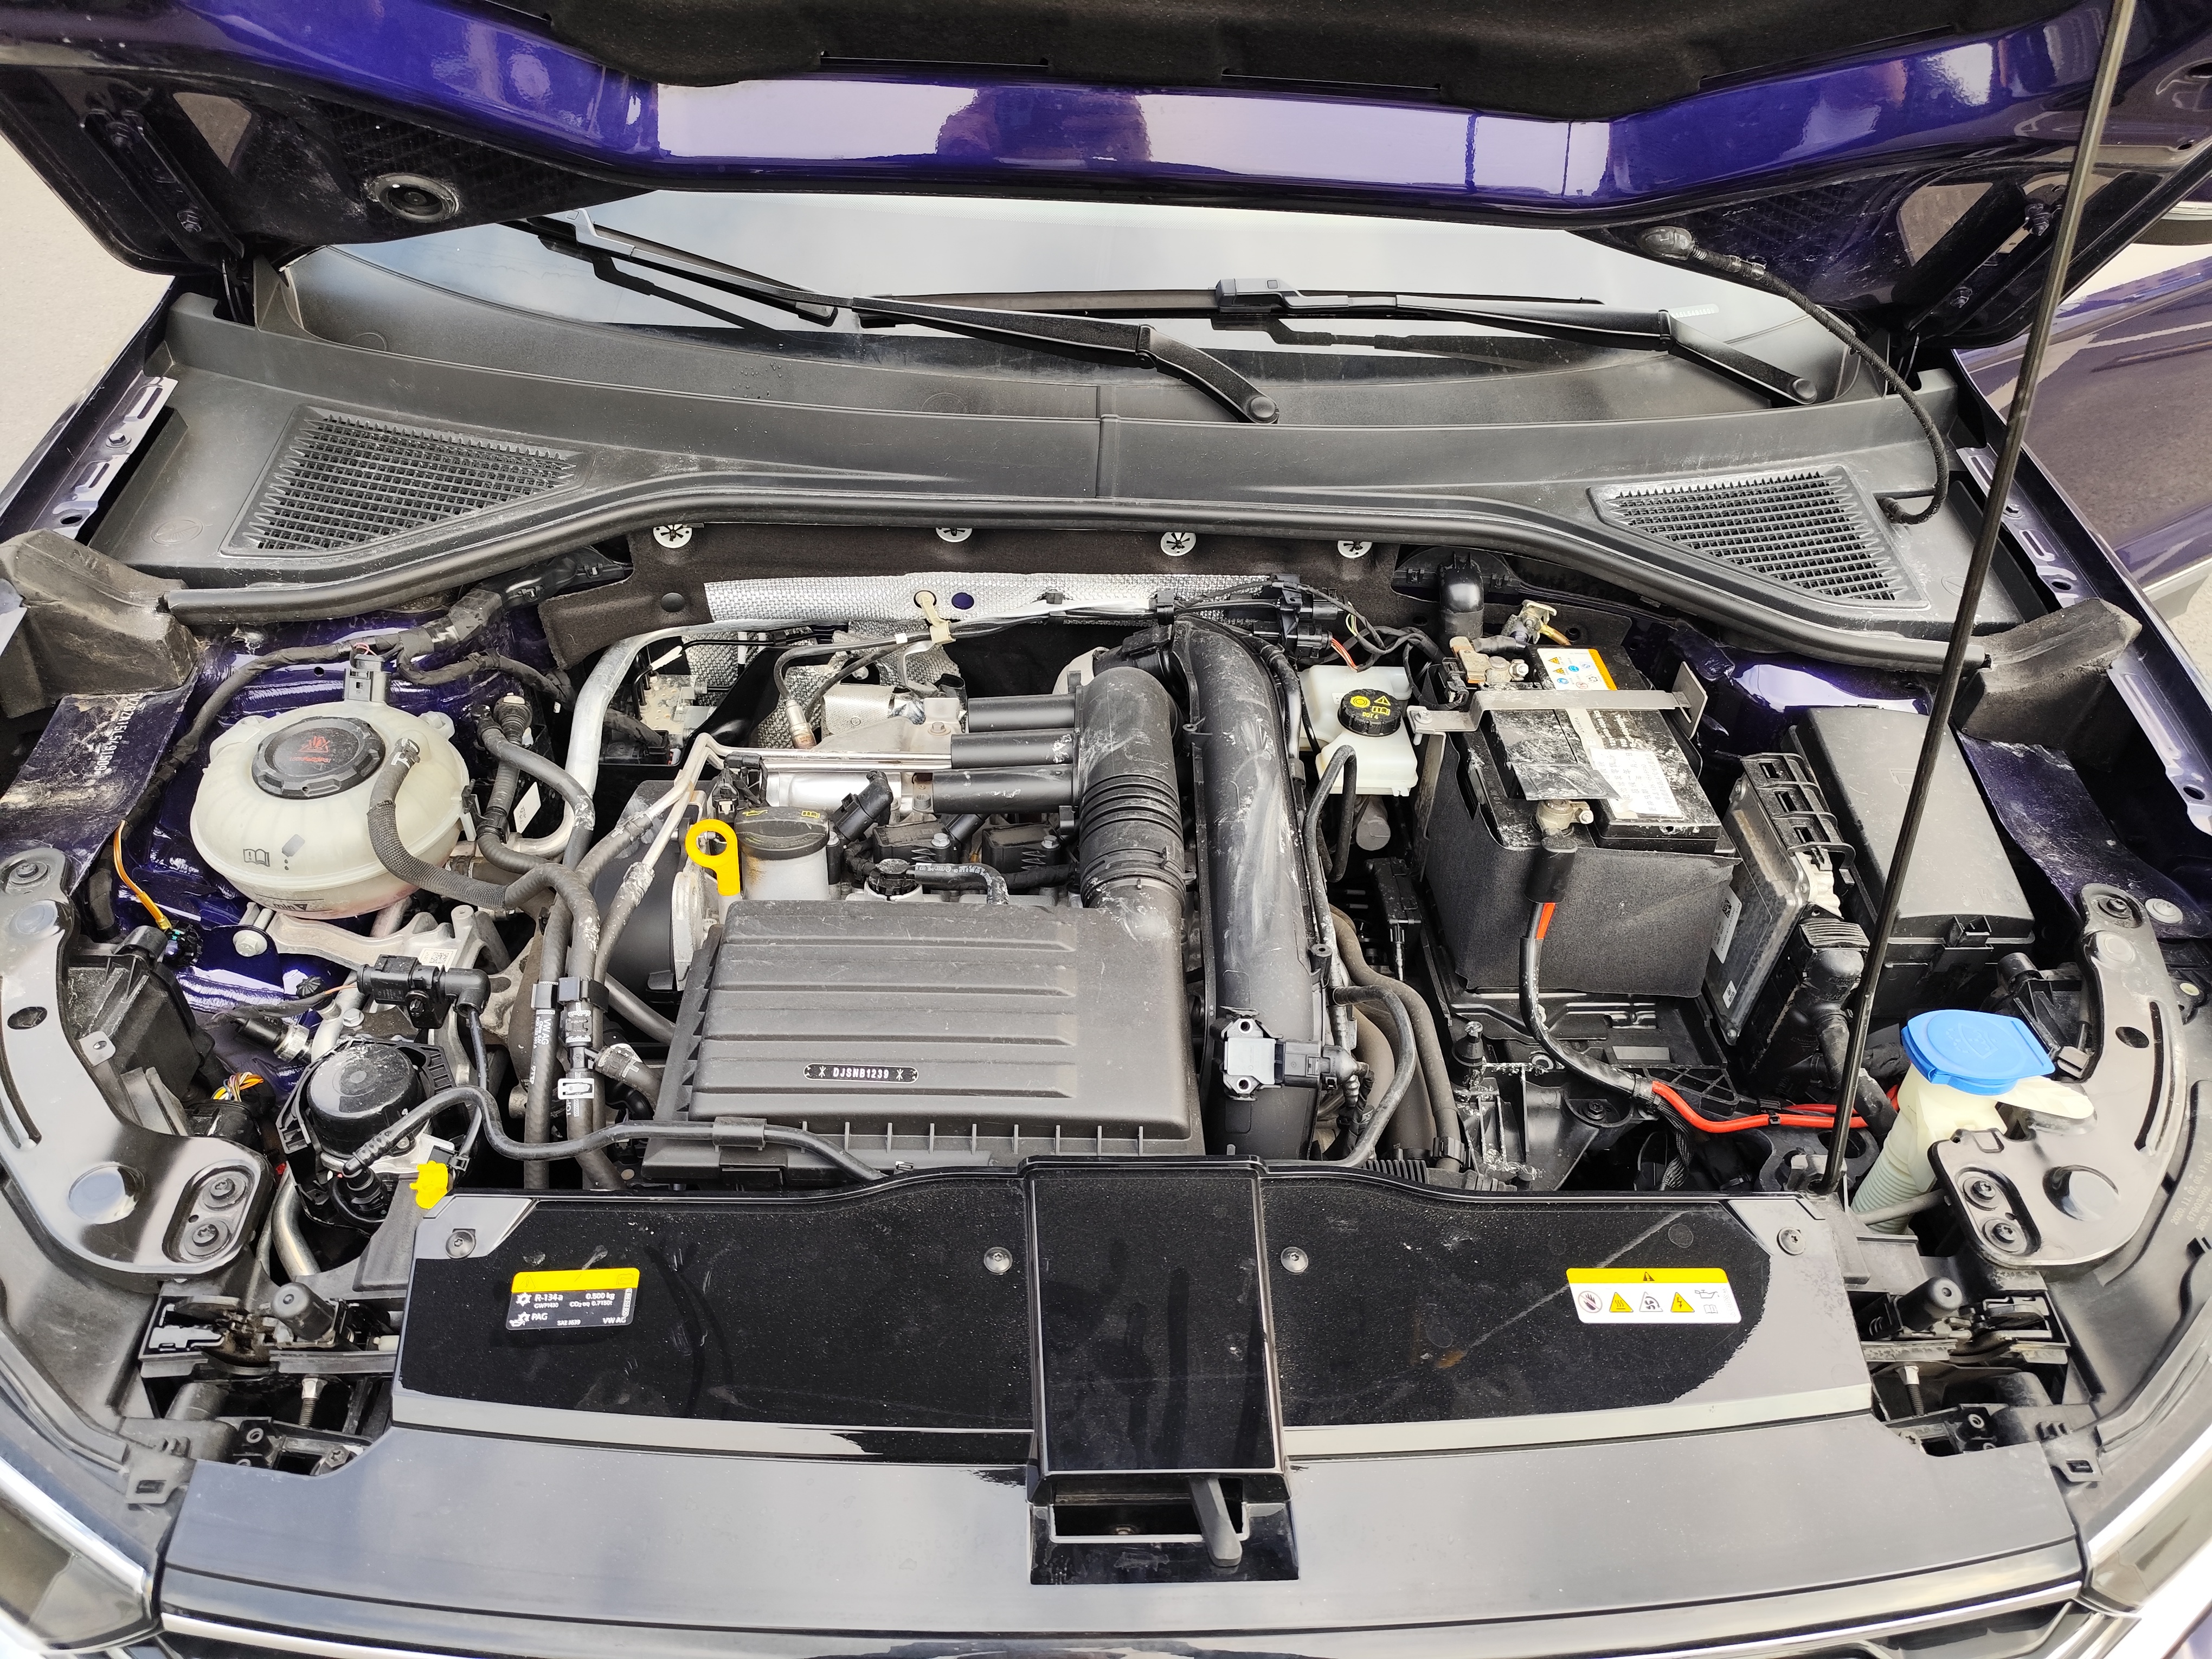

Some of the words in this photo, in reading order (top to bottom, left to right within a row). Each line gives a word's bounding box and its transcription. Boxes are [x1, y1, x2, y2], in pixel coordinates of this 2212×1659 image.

[272, 903, 296, 911] min
[543, 1018, 551, 1033] VW
[542, 1032, 549, 1045] AG
[833, 1067, 889, 1079] DJSNB1239
[2195, 1198, 2212, 1232] 2GD.94
[534, 1293, 563, 1302] R-134a
[531, 1313, 548, 1321] PAG
